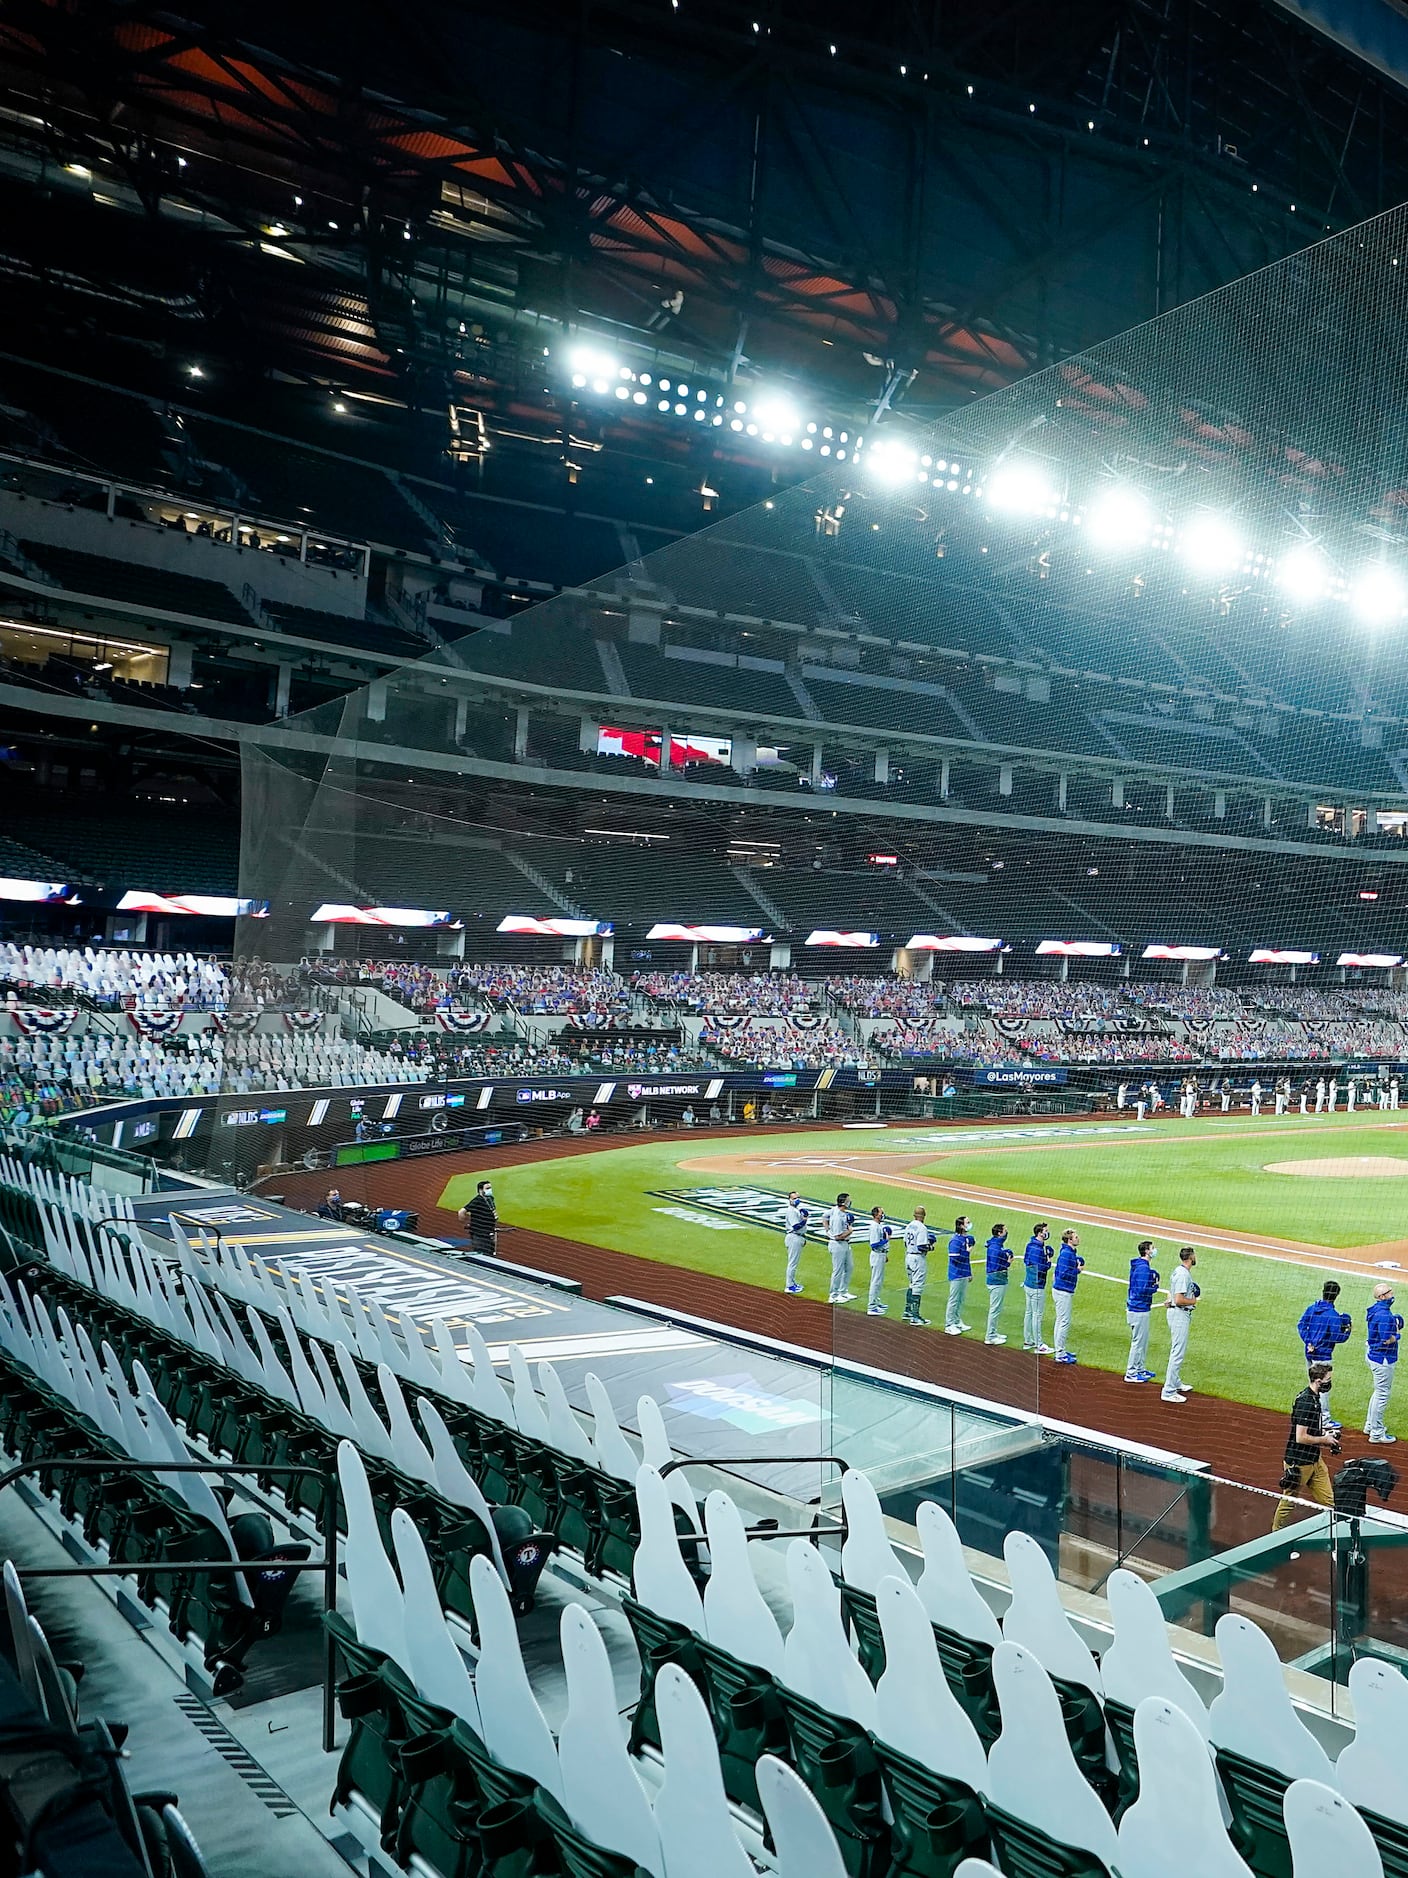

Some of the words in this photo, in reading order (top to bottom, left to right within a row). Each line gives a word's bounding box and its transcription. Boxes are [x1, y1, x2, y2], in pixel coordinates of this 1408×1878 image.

[986, 1071, 1057, 1083] @LasMayores
[532, 1090, 556, 1101] MLB
[556, 1091, 571, 1100] App
[641, 1086, 659, 1096] MLB
[659, 1085, 700, 1096] NETWORK
[409, 1141, 431, 1151] Globe
[431, 1139, 443, 1149] Life
